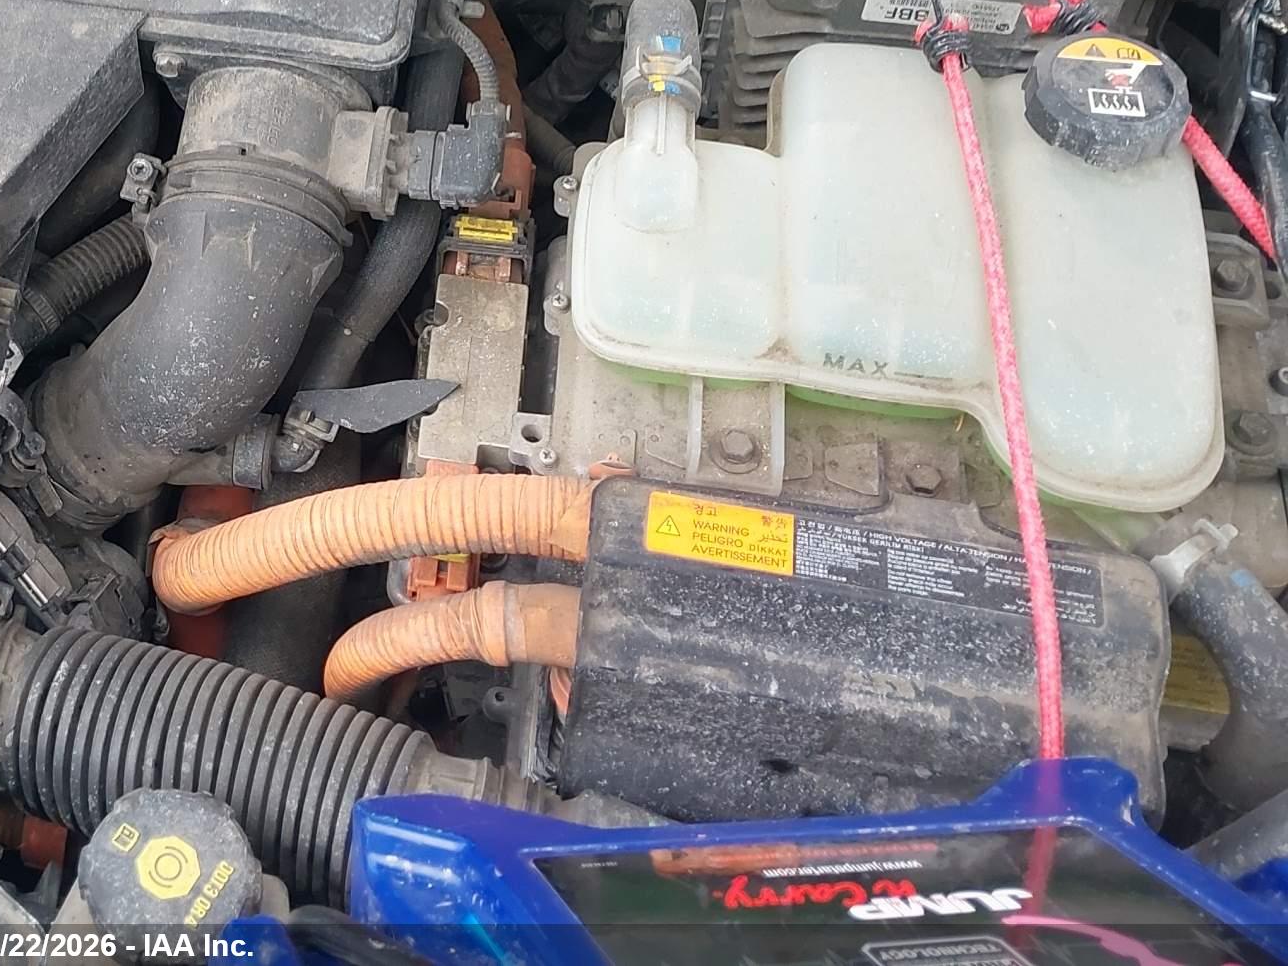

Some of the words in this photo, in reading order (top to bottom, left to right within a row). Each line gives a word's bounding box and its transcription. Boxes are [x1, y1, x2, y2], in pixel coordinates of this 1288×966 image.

[822, 352, 890, 379] MAX
[692, 519, 750, 537] WARNING
[692, 532, 744, 548] PELIGRO
[691, 544, 789, 569] AVERTISSEMENT
[846, 887, 1032, 921] JUMP
